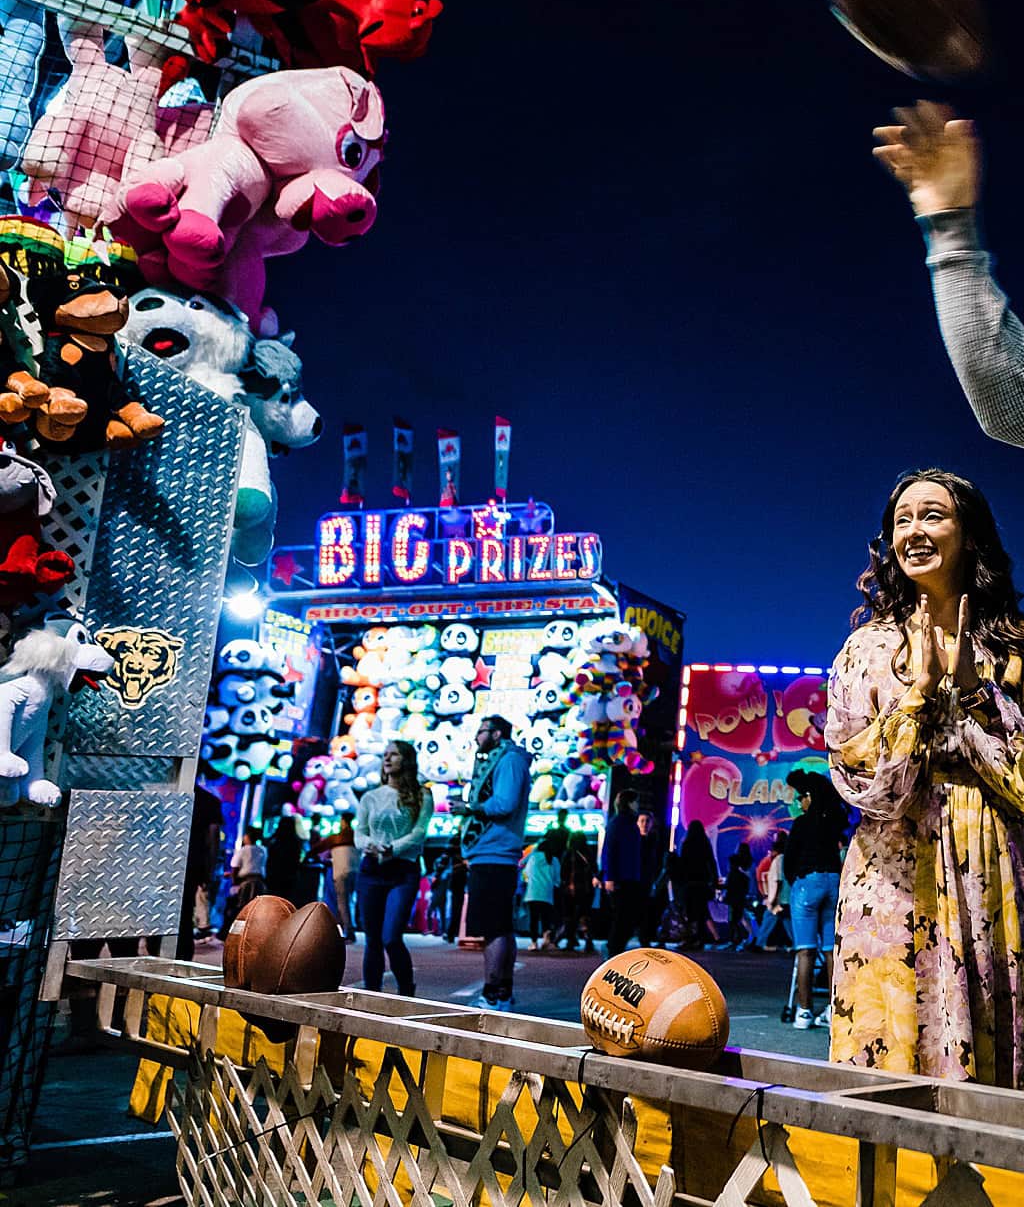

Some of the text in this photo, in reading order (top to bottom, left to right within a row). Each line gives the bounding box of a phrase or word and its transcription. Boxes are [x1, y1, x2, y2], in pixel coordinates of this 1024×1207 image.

[319, 513, 602, 585] BIG PRIZES
[307, 605, 400, 620] SHOOT
[408, 603, 460, 617] OUT
[475, 600, 532, 613] THE
